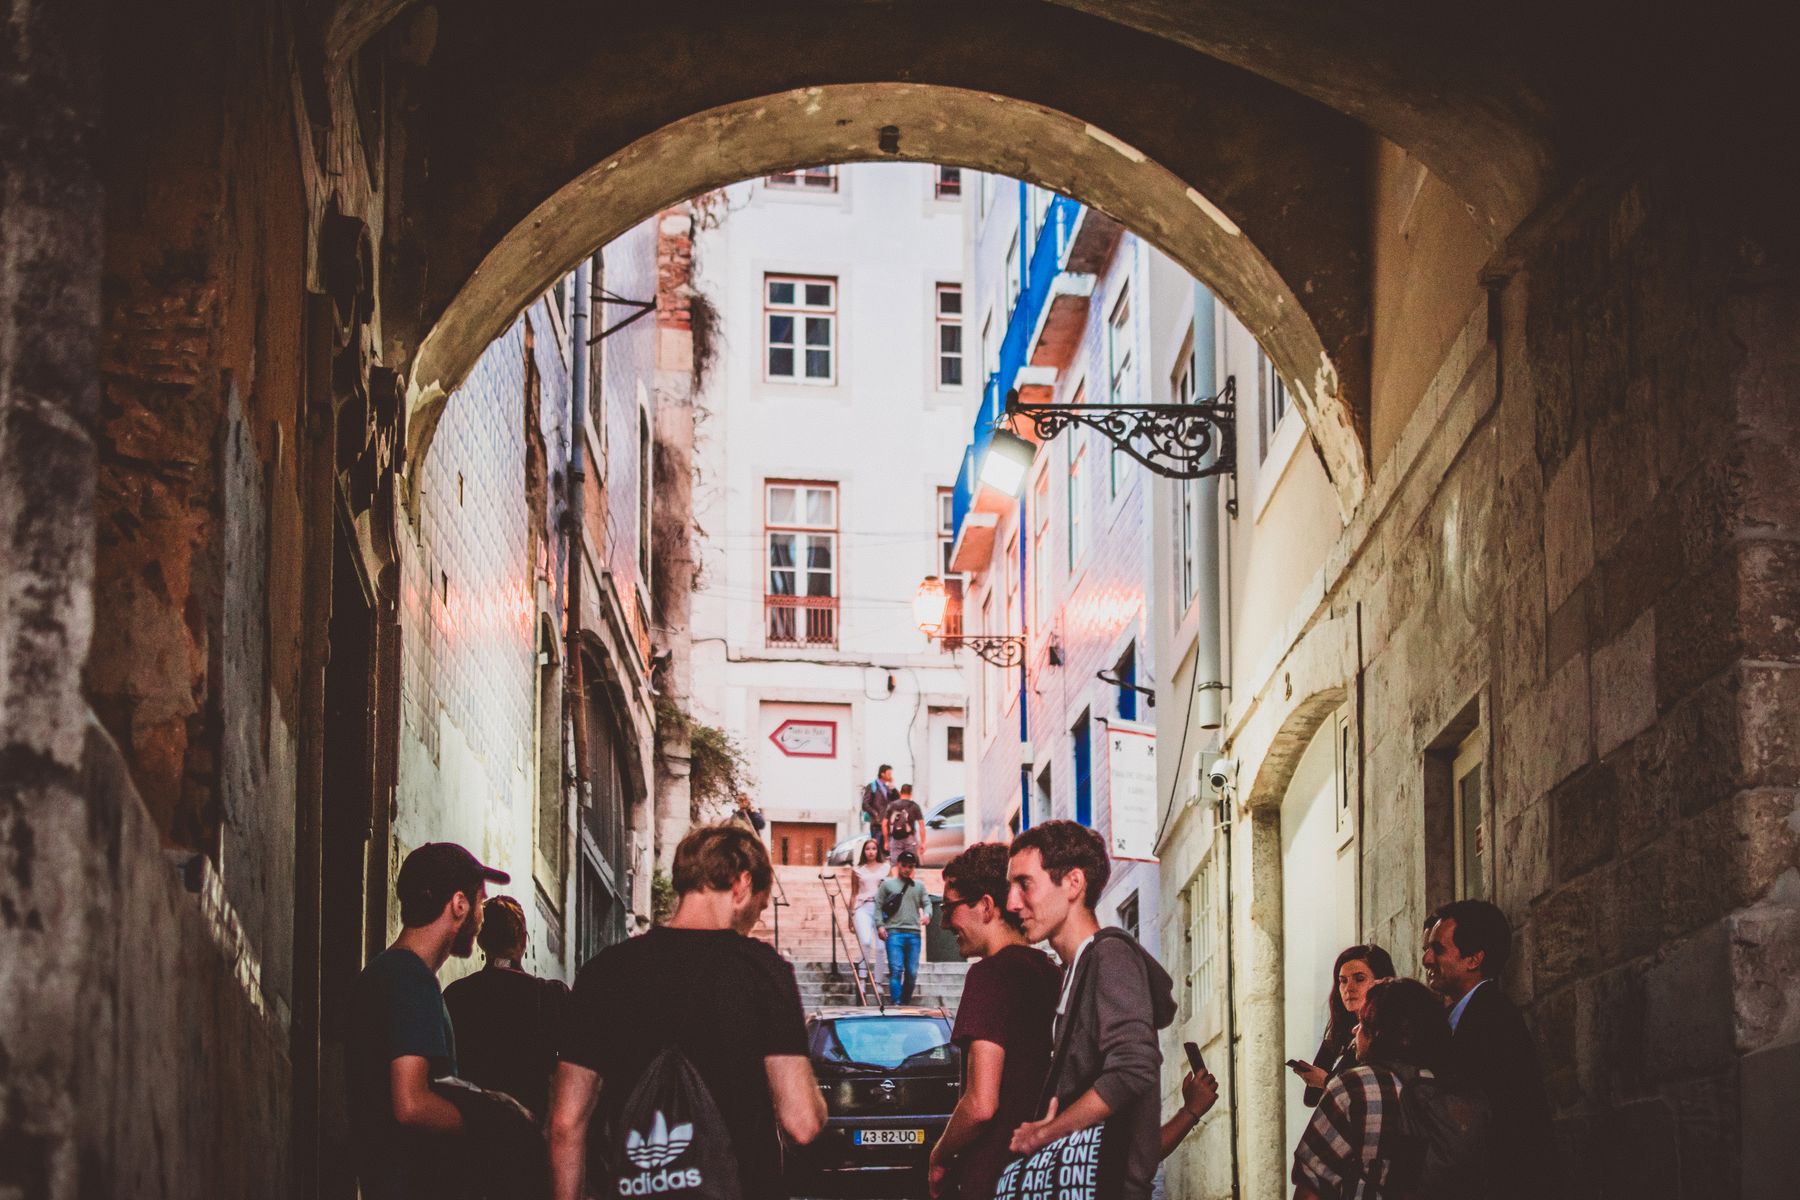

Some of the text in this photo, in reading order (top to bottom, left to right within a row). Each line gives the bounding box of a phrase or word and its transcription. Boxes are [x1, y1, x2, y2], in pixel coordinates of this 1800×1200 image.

[1062, 1144, 1101, 1164] ONE
[619, 1168, 702, 1195] adidas
[996, 1165, 1098, 1195] WE ARE ONE
